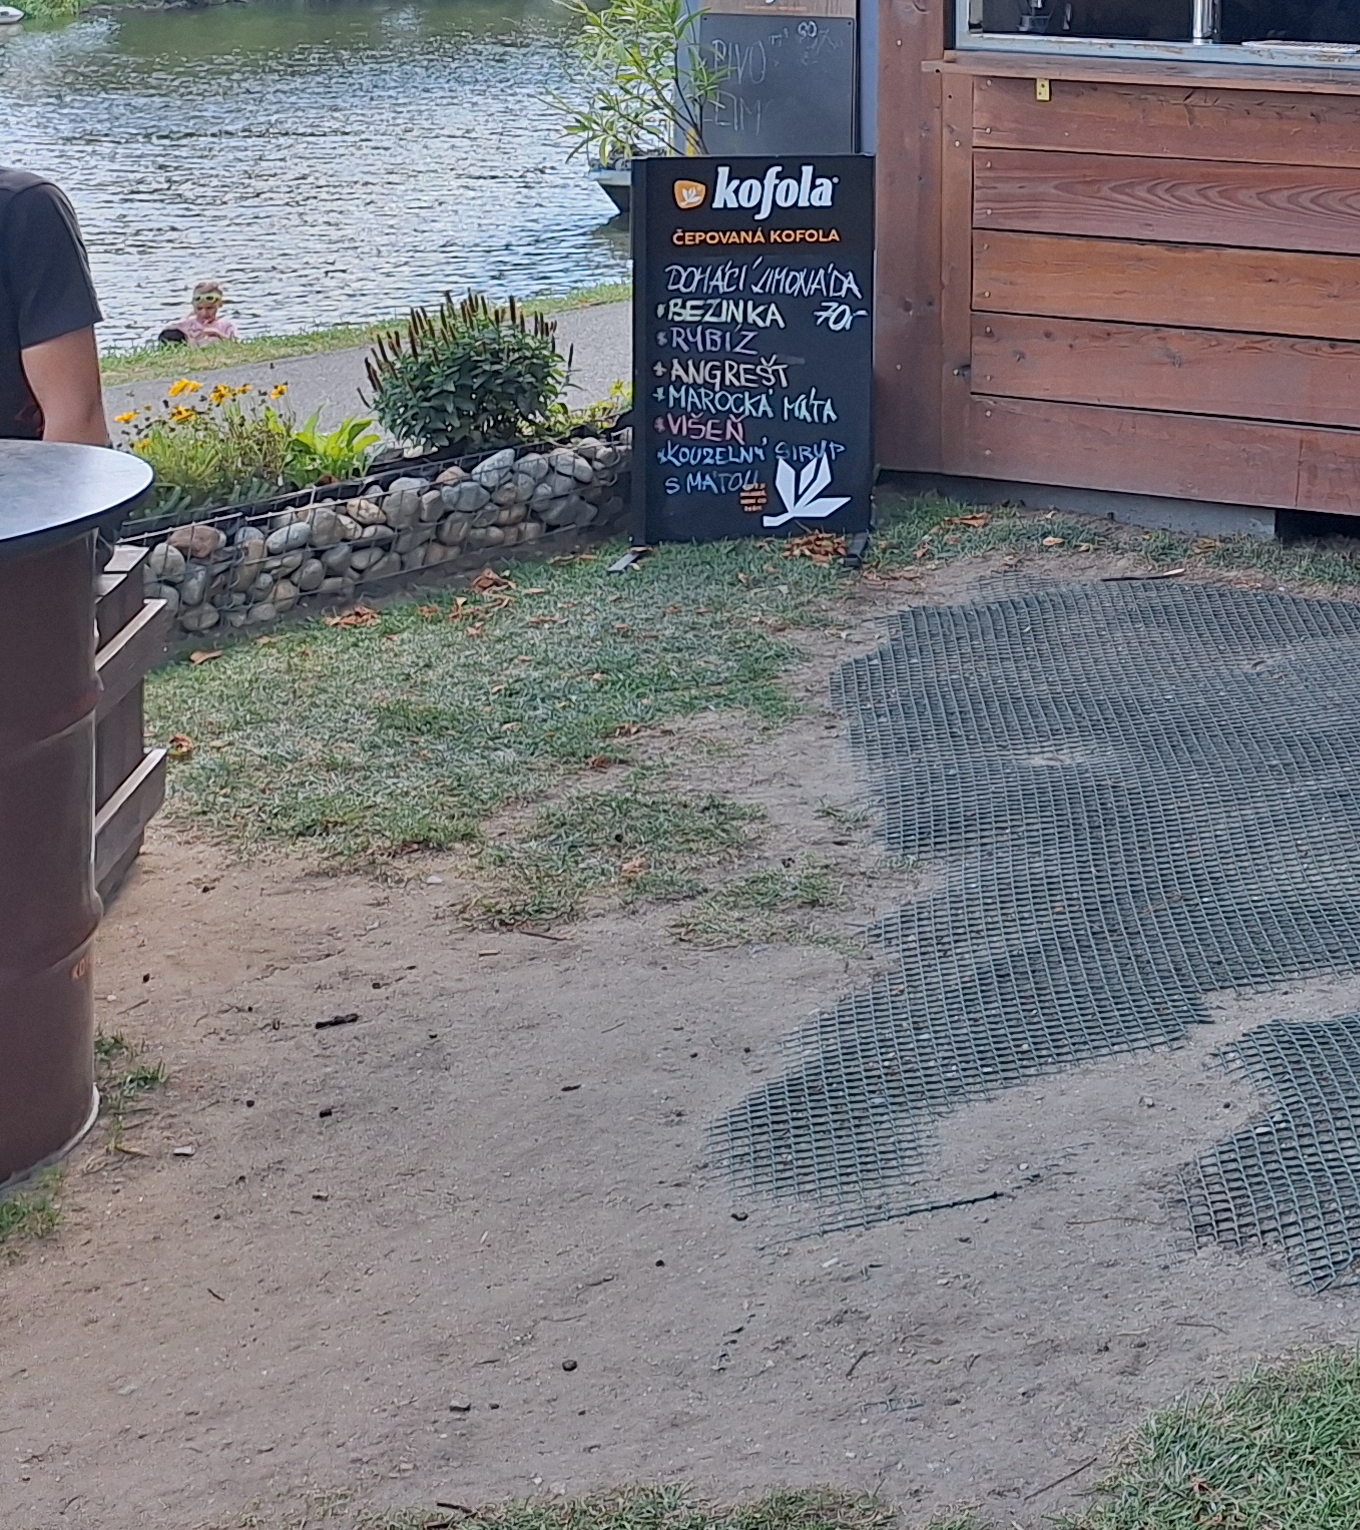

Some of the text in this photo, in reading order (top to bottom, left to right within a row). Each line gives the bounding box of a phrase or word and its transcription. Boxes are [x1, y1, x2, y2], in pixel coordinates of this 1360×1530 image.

[712, 165, 834, 220] kofola
[672, 227, 841, 246] ČEPOVANÁ KOFOLA
[668, 297, 786, 329] BEZINKA
[670, 323, 759, 356] RYBÍZ
[670, 354, 788, 391] ANGREŠT
[668, 385, 838, 423] MAROCKÁ MÁTA
[667, 412, 746, 446] VIŠEŇ
[774, 440, 846, 461] SIRUP
